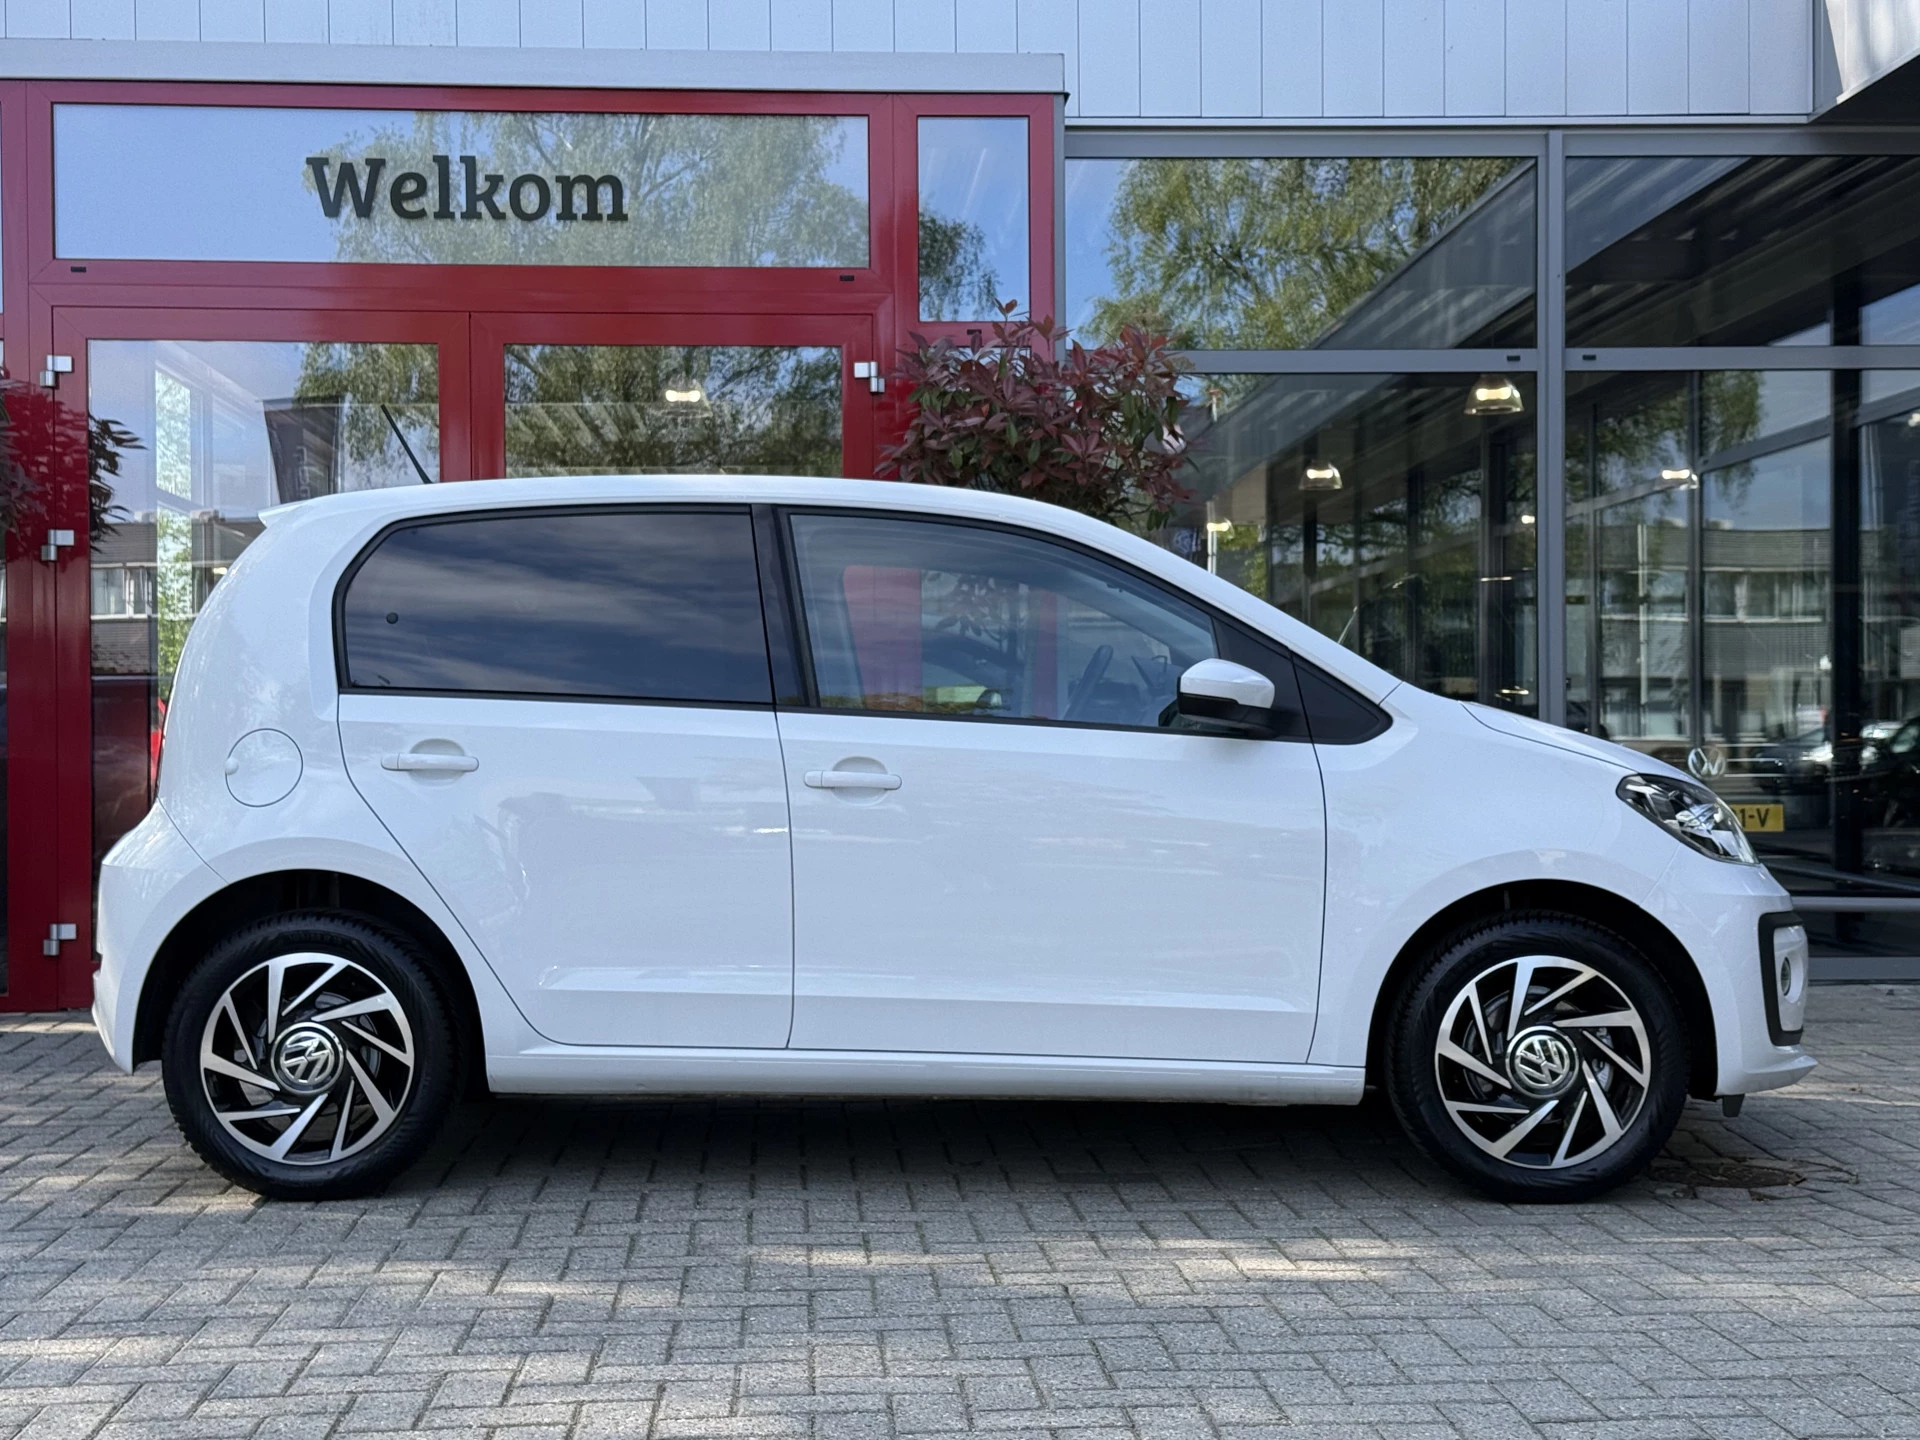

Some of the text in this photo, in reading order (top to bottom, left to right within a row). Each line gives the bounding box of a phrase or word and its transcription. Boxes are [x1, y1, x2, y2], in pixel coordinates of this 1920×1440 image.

[305, 154, 629, 222] Welkom
[1731, 807, 1770, 829] 1-V
[1514, 1034, 1571, 1090] VW
